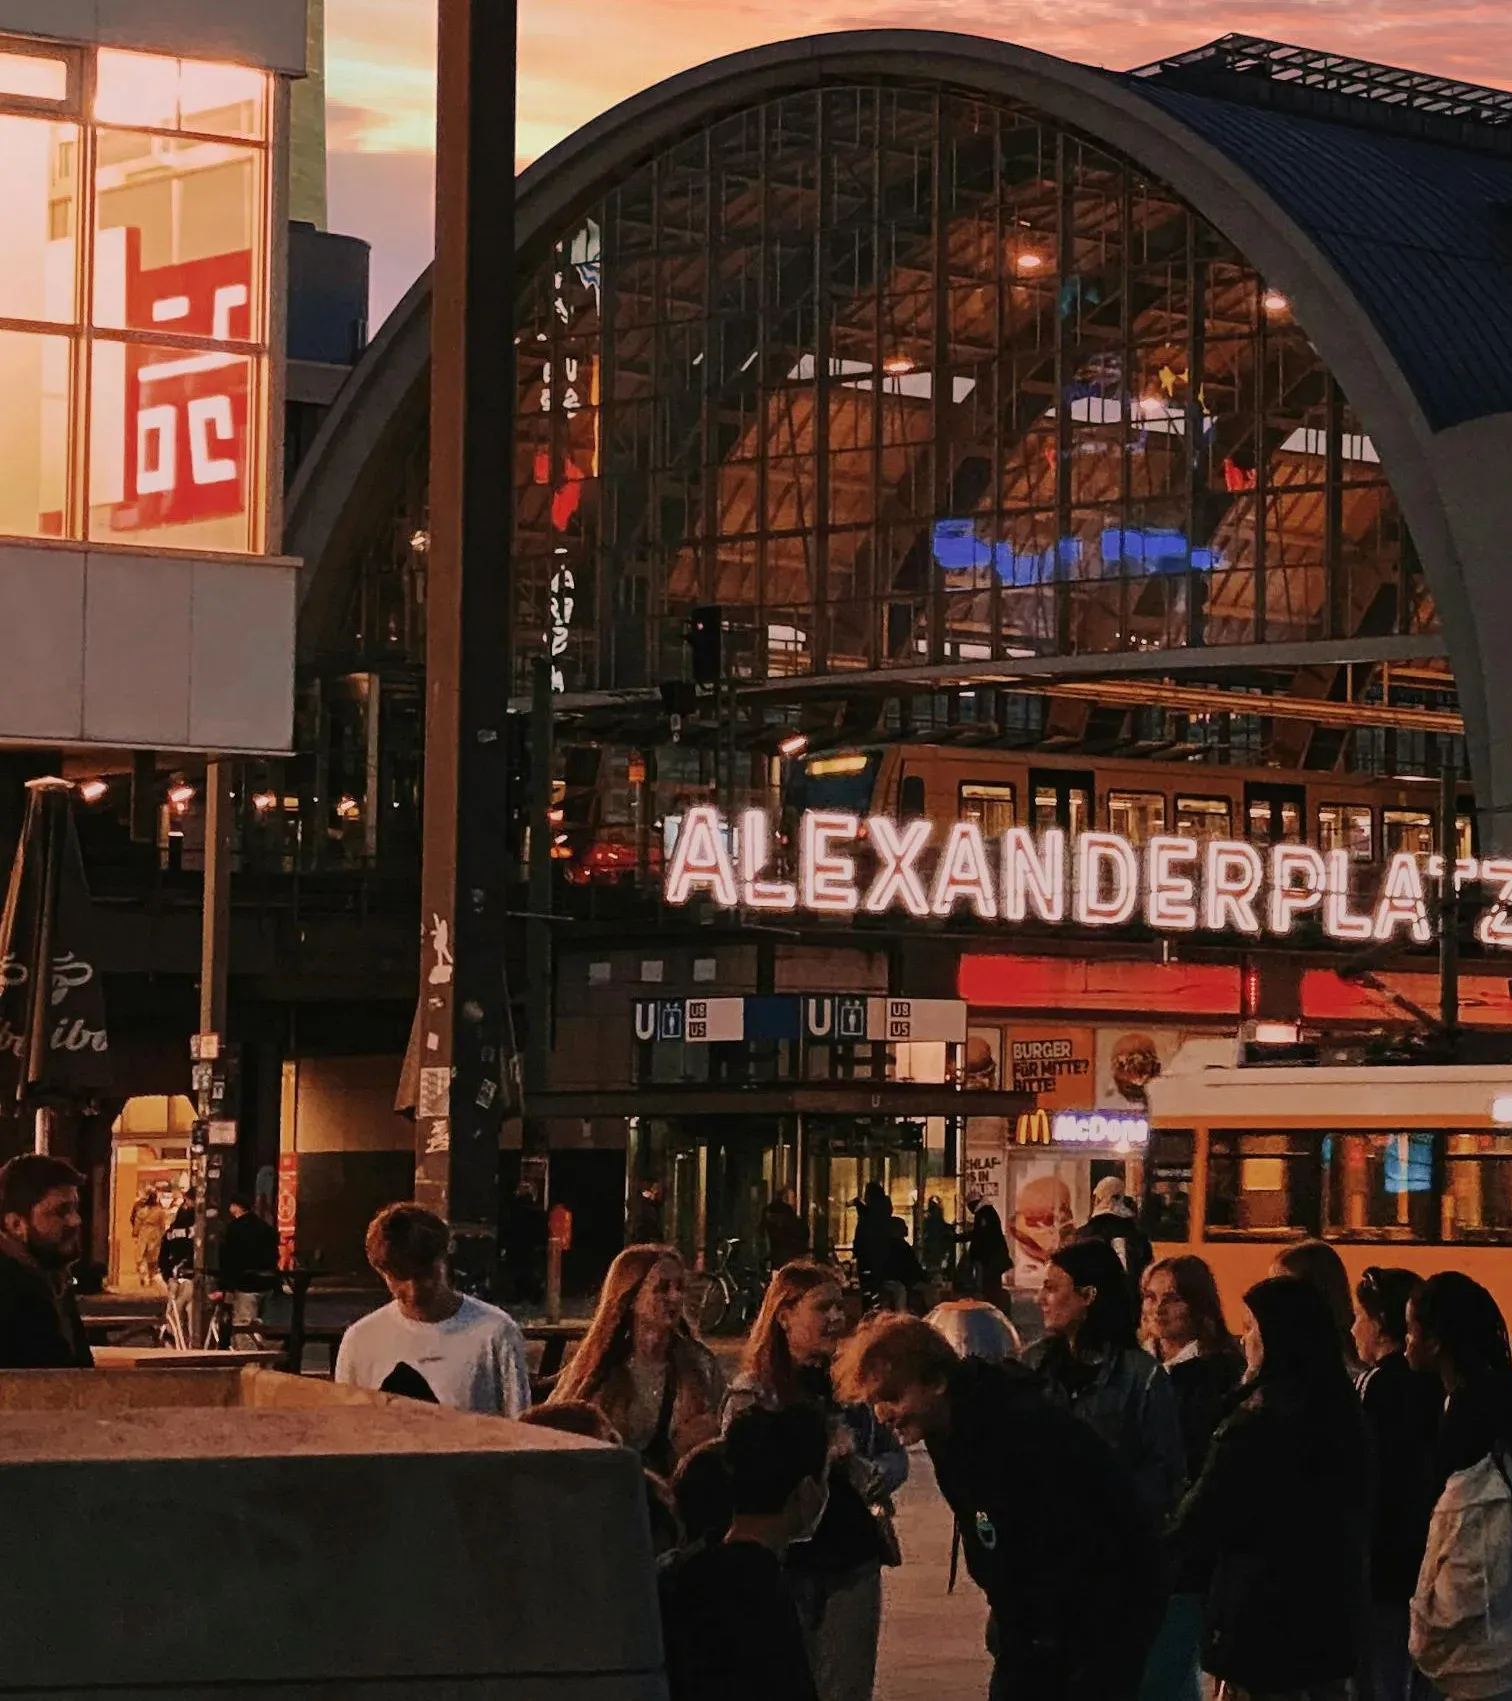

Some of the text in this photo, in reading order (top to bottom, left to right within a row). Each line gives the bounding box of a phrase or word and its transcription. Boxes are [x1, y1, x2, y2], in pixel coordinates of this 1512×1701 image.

[635, 1003, 655, 1040] U
[808, 999, 832, 1036] U
[1013, 1041, 1071, 1060] BURGER
